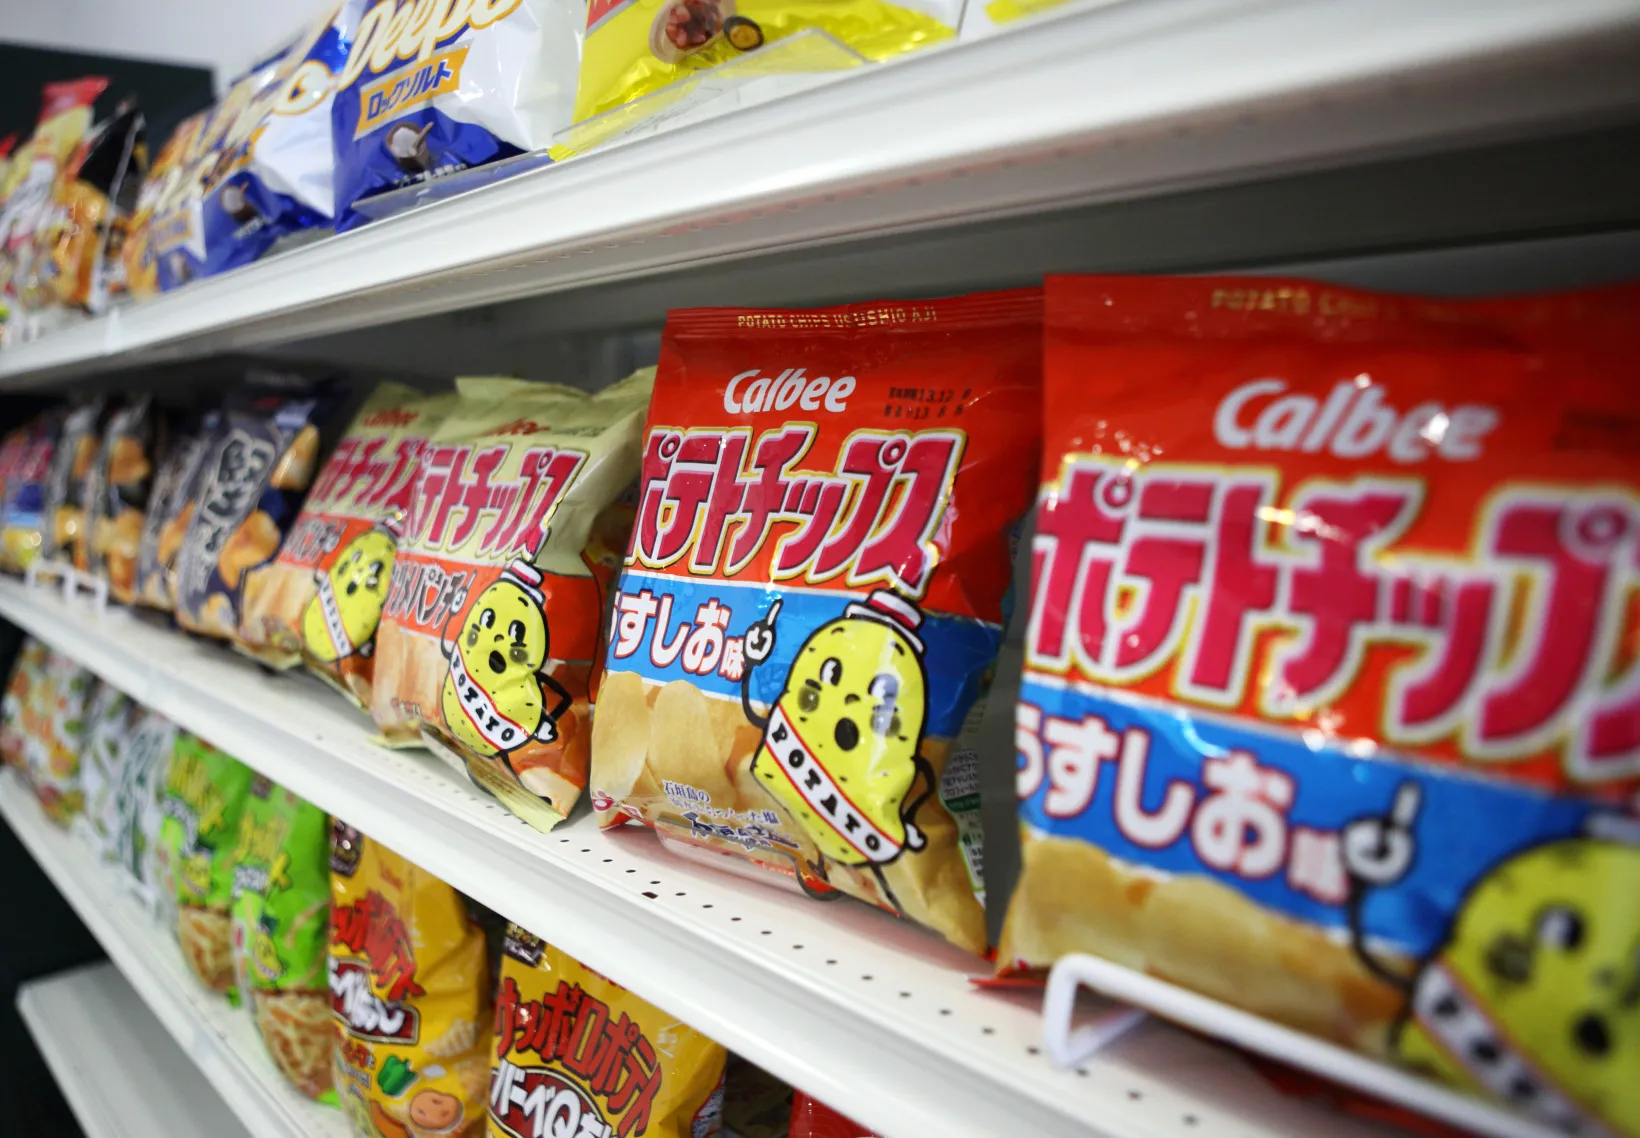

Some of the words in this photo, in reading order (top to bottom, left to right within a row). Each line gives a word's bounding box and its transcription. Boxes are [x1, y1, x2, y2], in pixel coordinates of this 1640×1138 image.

[366, 61, 452, 119] ロックソルト
[737, 315, 786, 328] POTATO
[789, 314, 831, 328] CHIPS
[911, 306, 937, 322] AJI
[723, 368, 857, 415] Calbee
[1213, 378, 1498, 462] Calbee
[624, 421, 968, 599] ポテトチップス
[1024, 455, 1640, 784] ポテトチップ
[451, 655, 516, 742] POTATO
[771, 722, 881, 853] POTATO
[494, 976, 664, 1138] サッポロポテト
